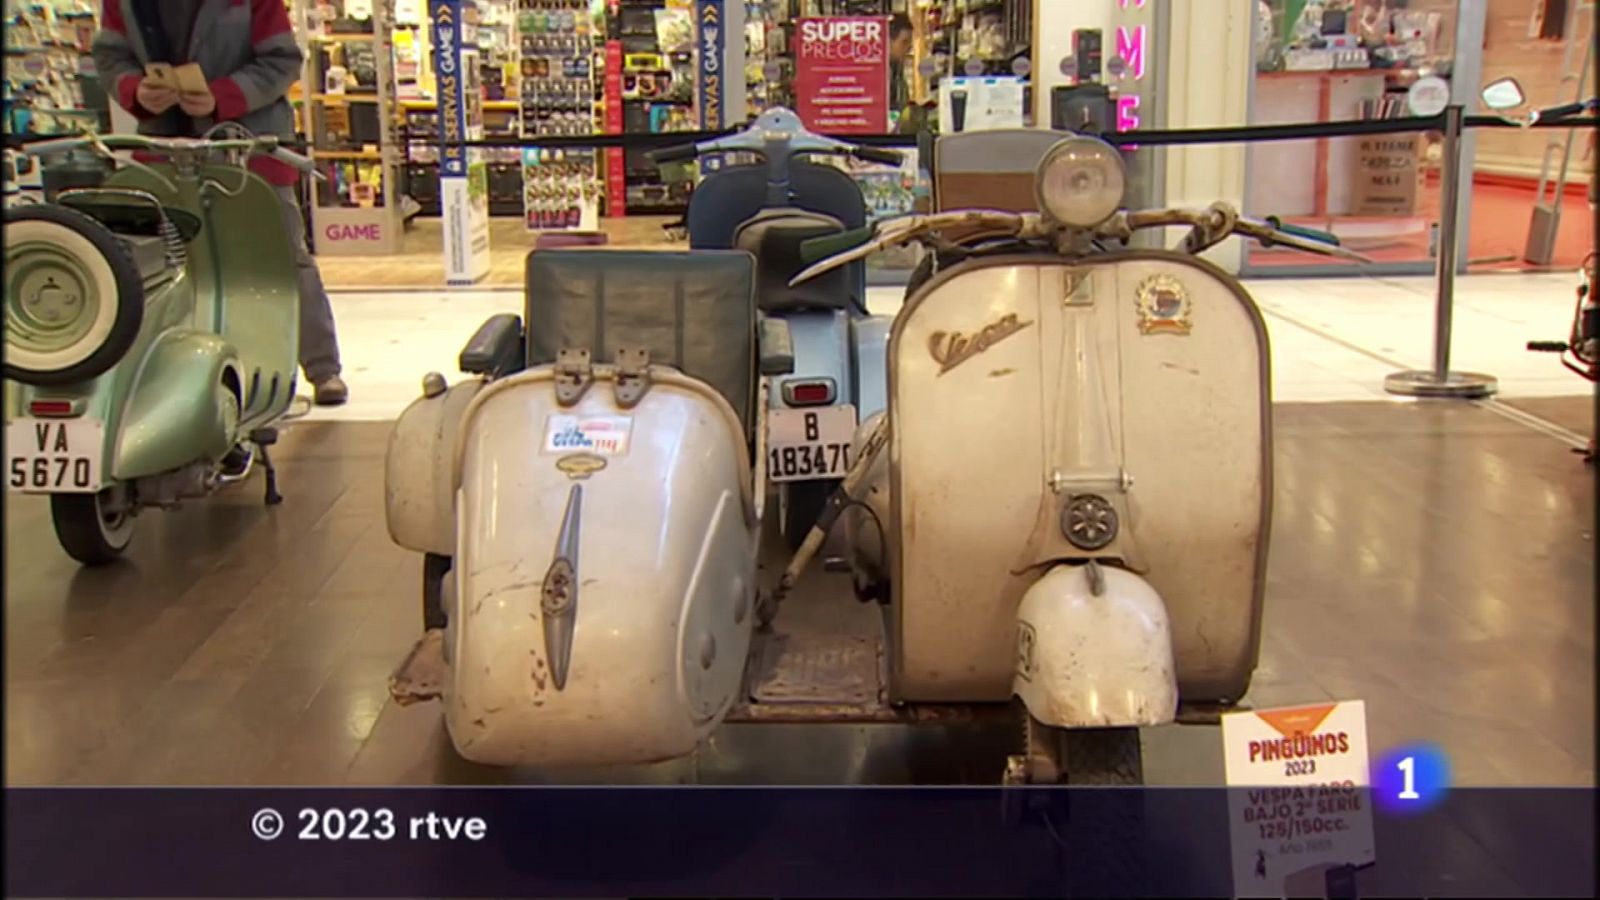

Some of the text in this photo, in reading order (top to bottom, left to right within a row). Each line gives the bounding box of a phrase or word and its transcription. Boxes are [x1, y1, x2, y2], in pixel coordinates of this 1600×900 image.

[802, 19, 881, 41] SÚPER
[703, 27, 718, 72] GAME
[802, 41, 882, 59] PRECIOS
[438, 27, 459, 158] RSERVAS GAME
[325, 224, 381, 241] GAME
[36, 422, 68, 452] VA
[805, 412, 818, 441] B
[11, 457, 90, 487] 5670
[1249, 730, 1349, 762] PINGÜINOS
[1285, 760, 1316, 776] 2023
[1248, 780, 1355, 805] VESPA FARO
[1243, 803, 1292, 822] BAJO
[1317, 794, 1361, 815] SERIE
